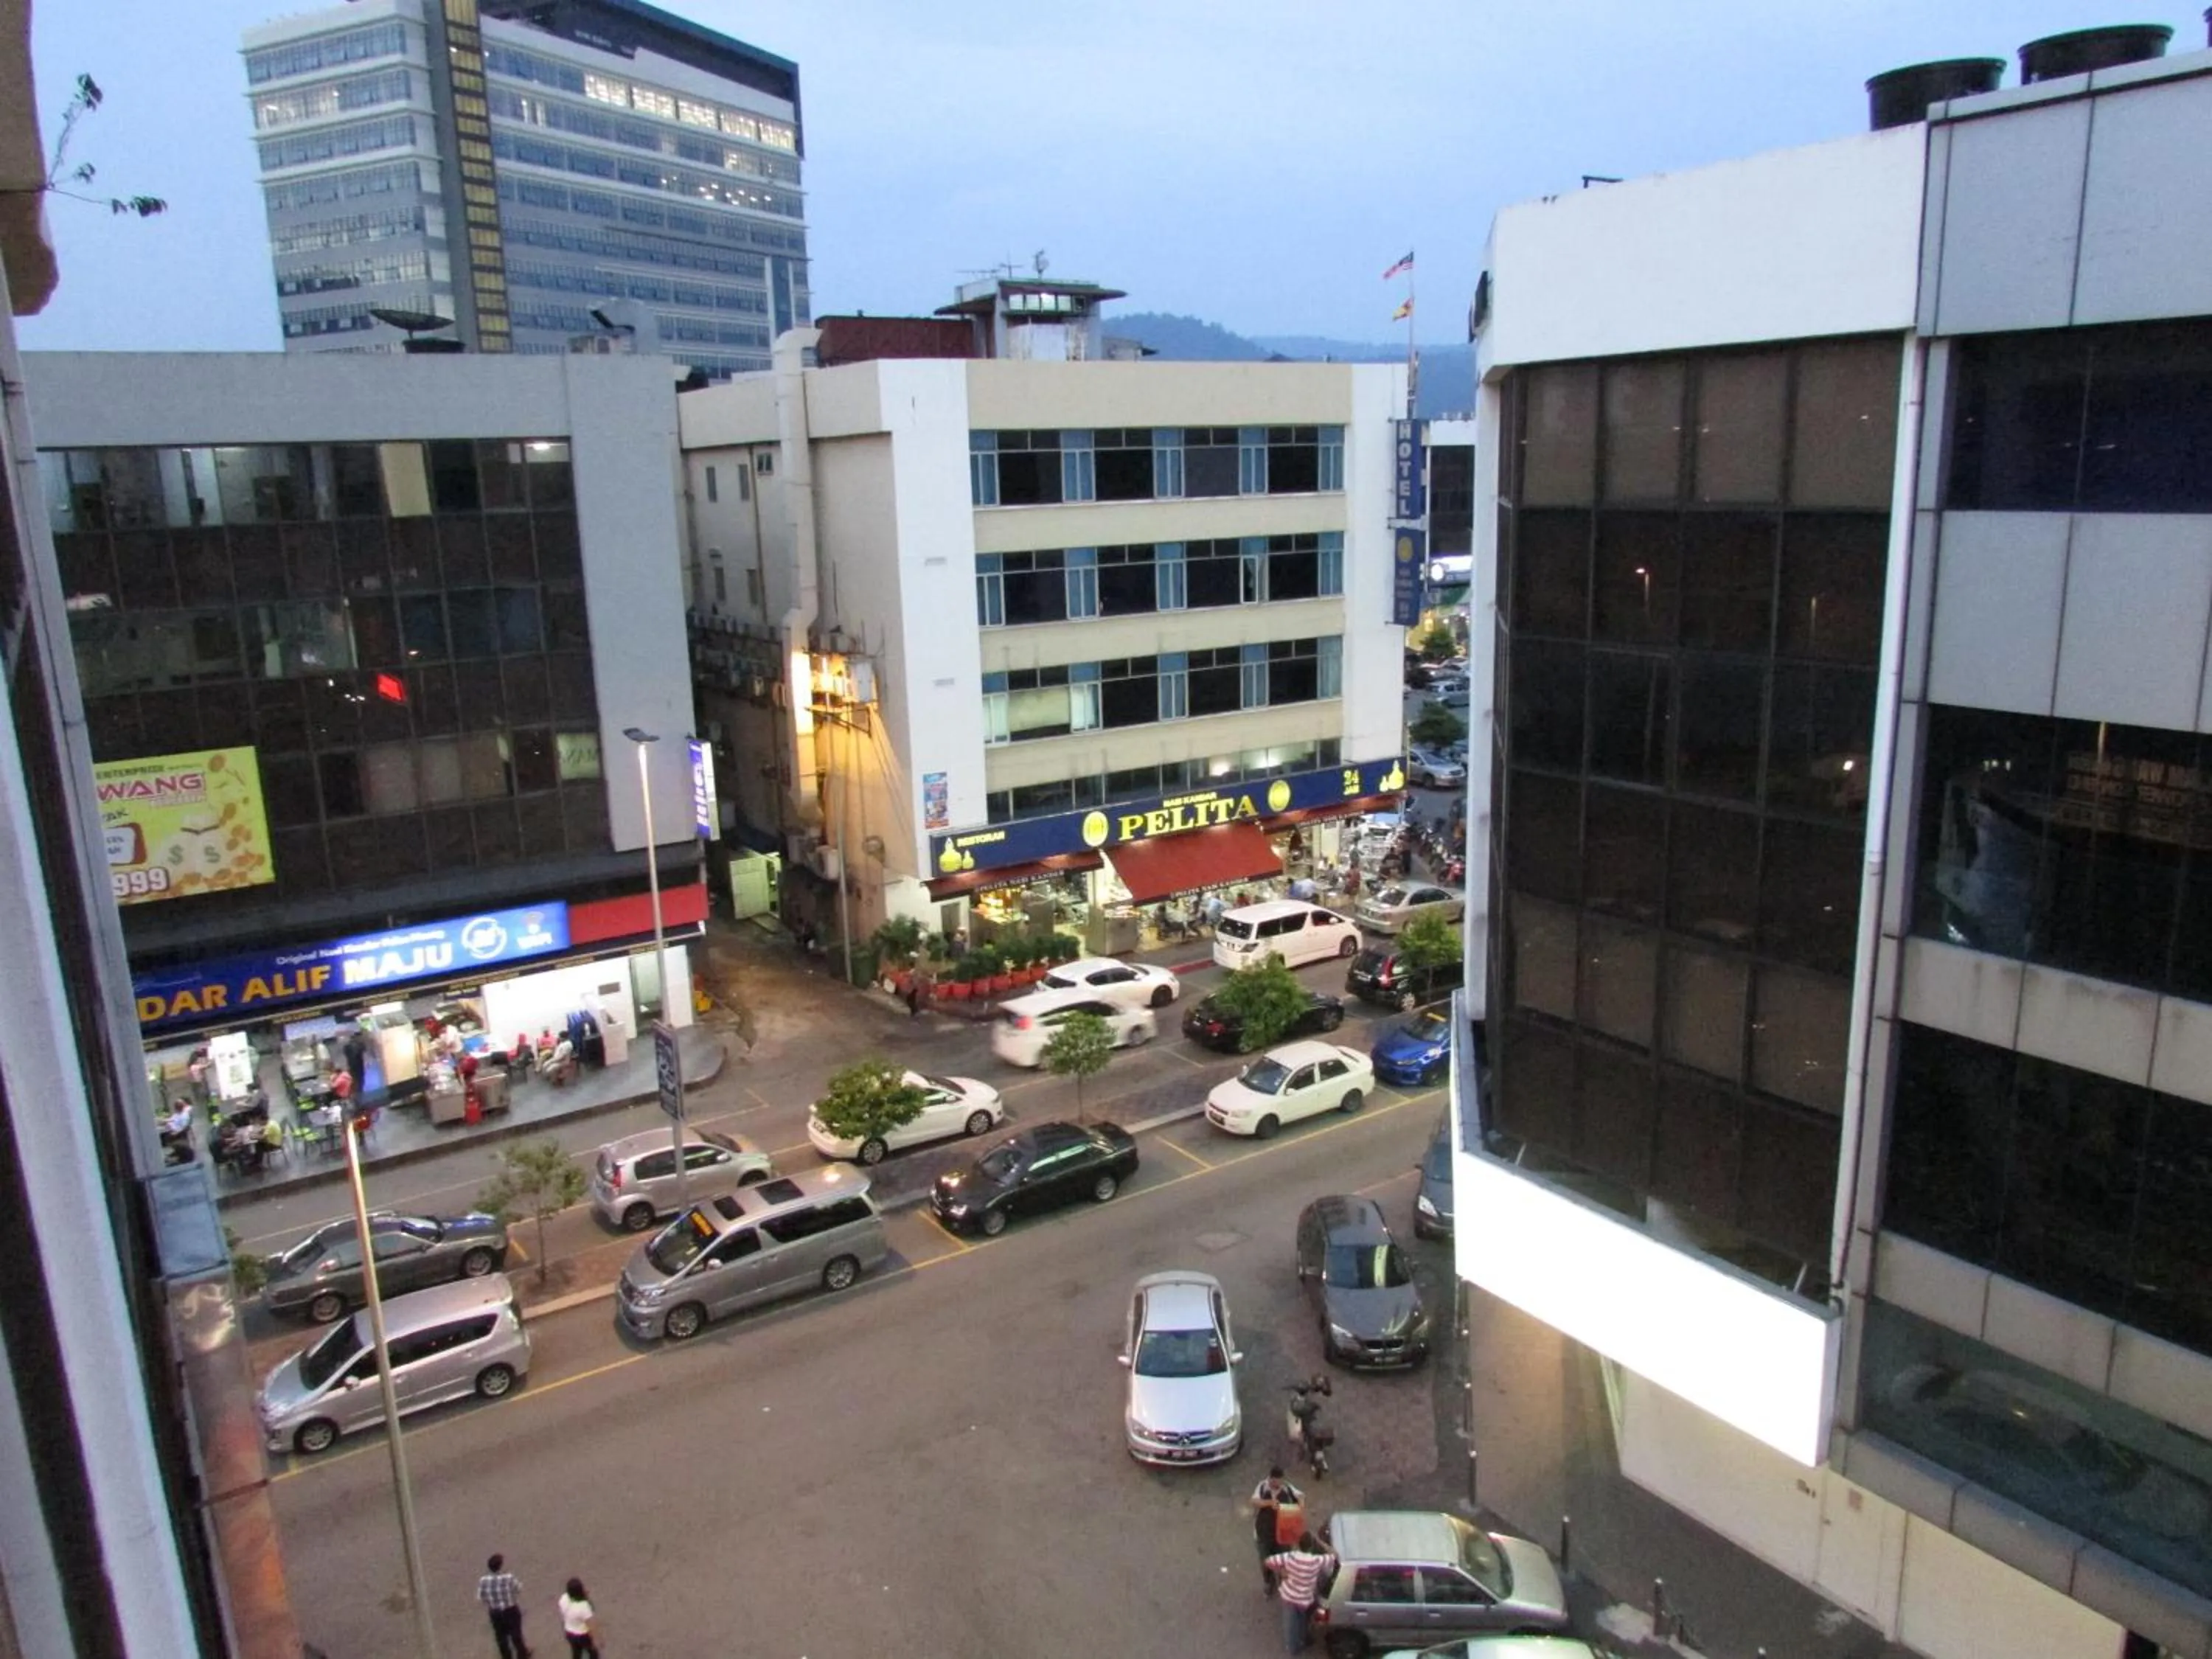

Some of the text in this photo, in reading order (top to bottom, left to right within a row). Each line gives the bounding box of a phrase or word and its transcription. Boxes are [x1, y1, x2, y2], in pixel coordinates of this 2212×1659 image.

[1398, 421, 1412, 515] HOTEL
[97, 773, 203, 801] WANG
[1343, 769, 1360, 785] 24
[1118, 795, 1259, 841] PELITA
[240, 964, 331, 1004] ALIF
[342, 942, 453, 985] MAJU
